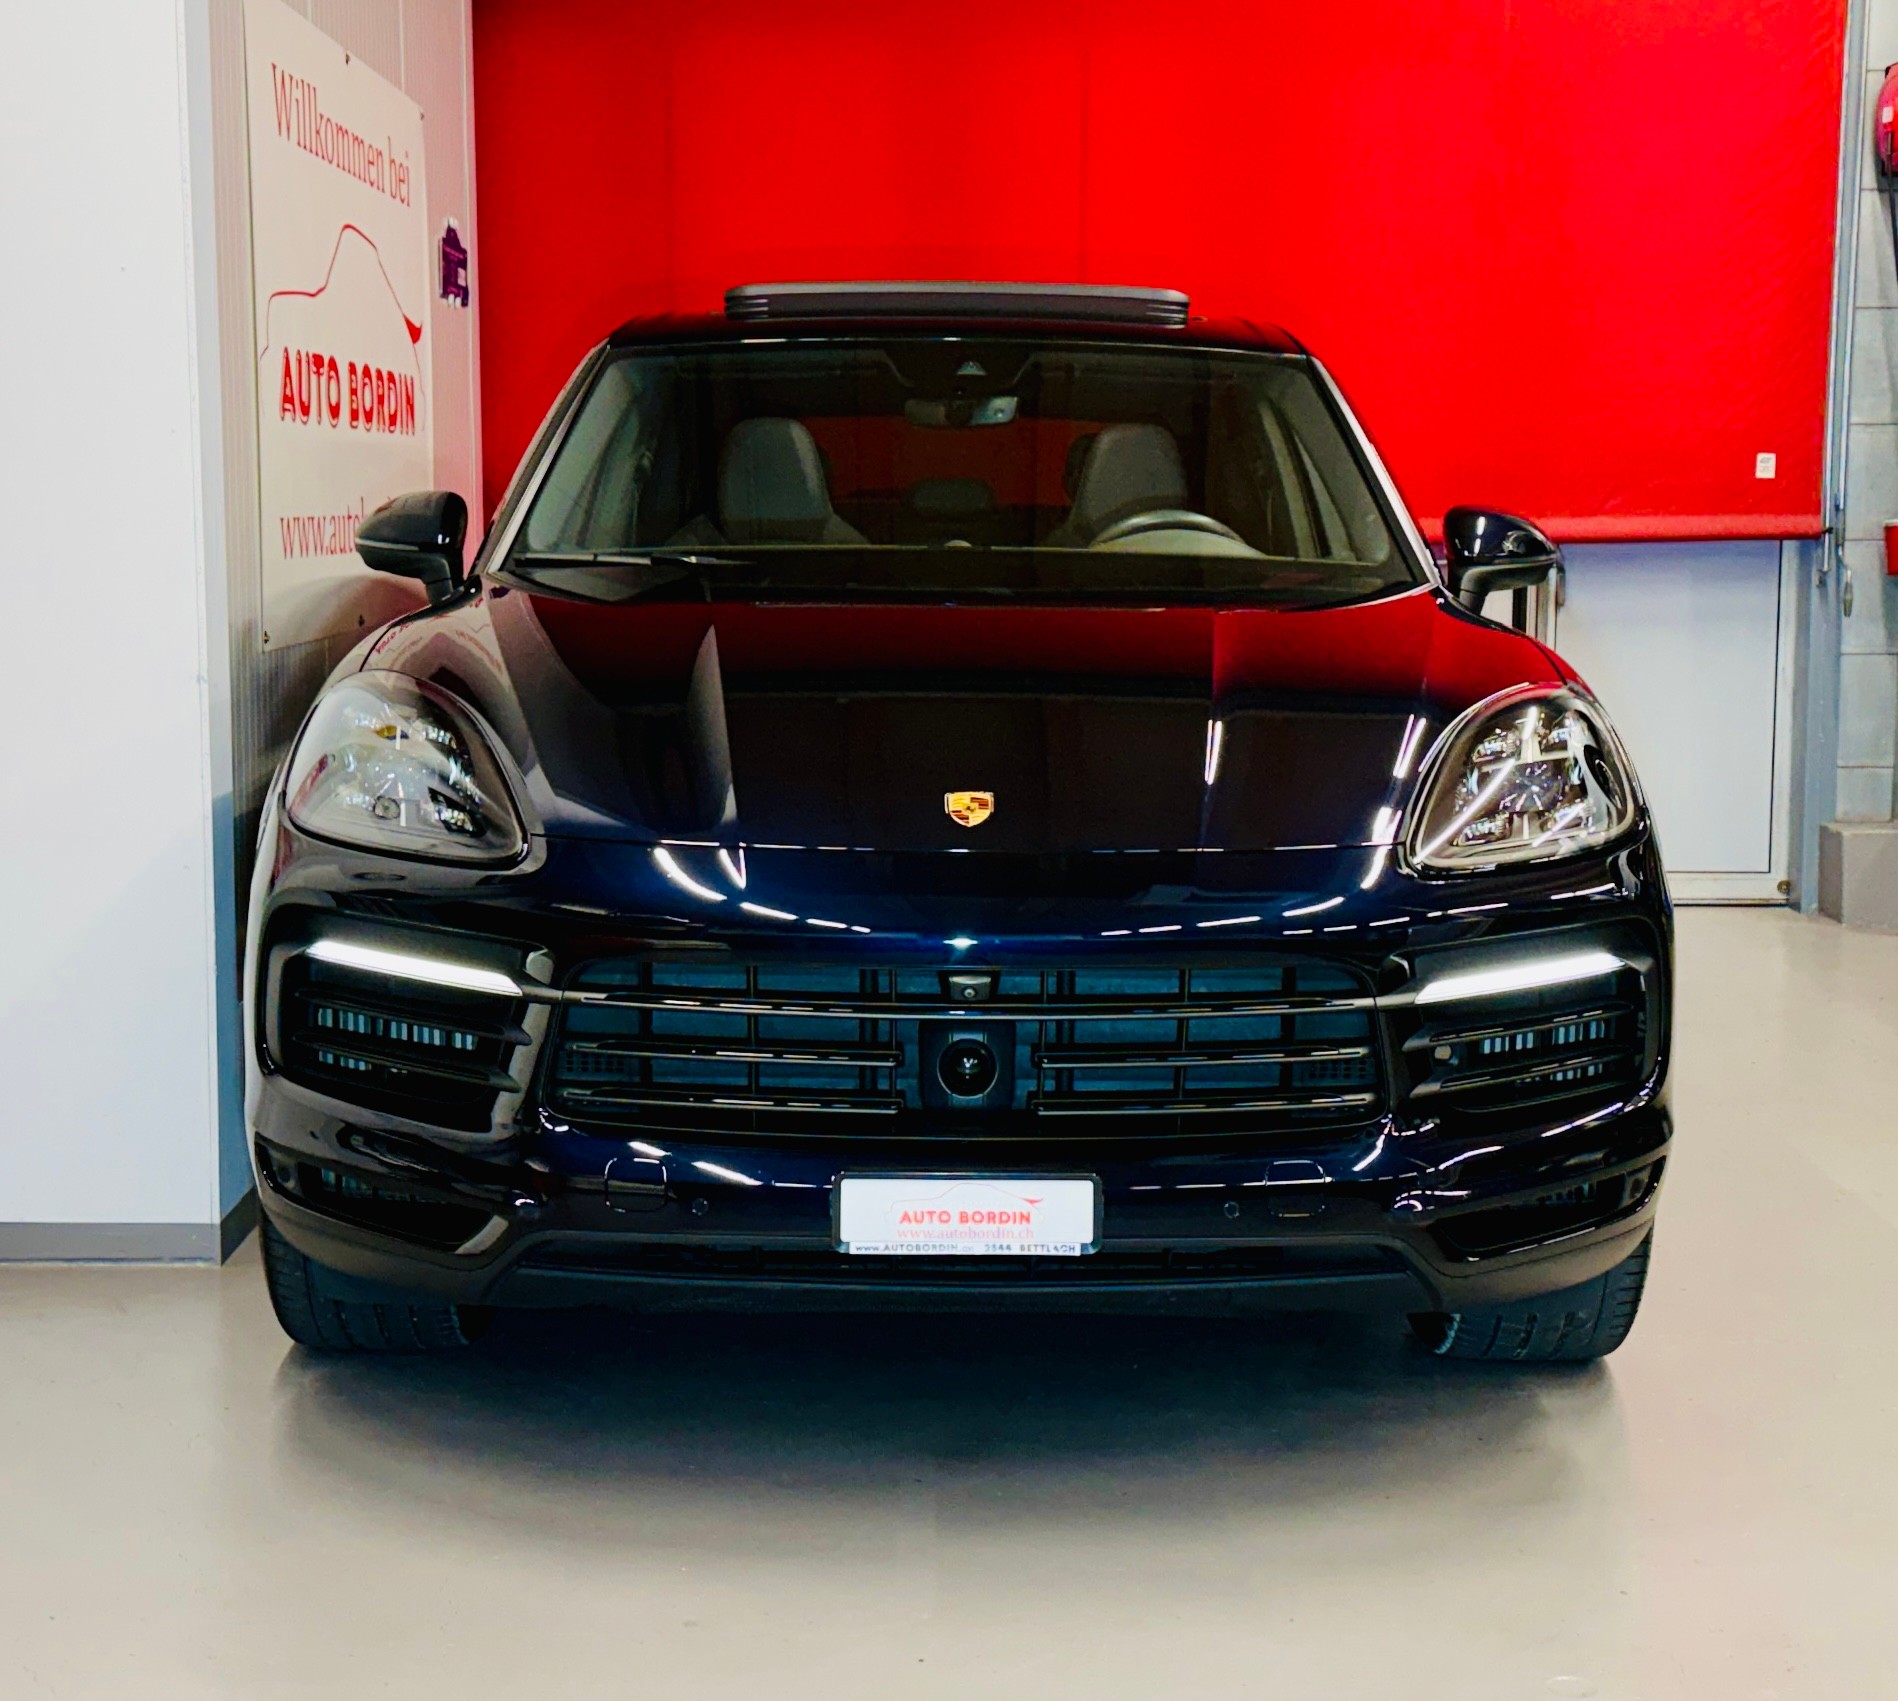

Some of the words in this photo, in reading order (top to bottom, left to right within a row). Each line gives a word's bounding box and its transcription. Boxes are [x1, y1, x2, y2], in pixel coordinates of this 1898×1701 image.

[271, 62, 385, 193] Willkommen
[387, 136, 410, 207] bei
[279, 346, 341, 428] AUTO
[348, 361, 415, 436] BORDIN
[899, 1210, 951, 1225] AUTO
[959, 1210, 1031, 1225] BORDIN
[897, 1226, 1034, 1240] www.autobordin.ch
[1019, 1244, 1076, 1253] BETTLACH
